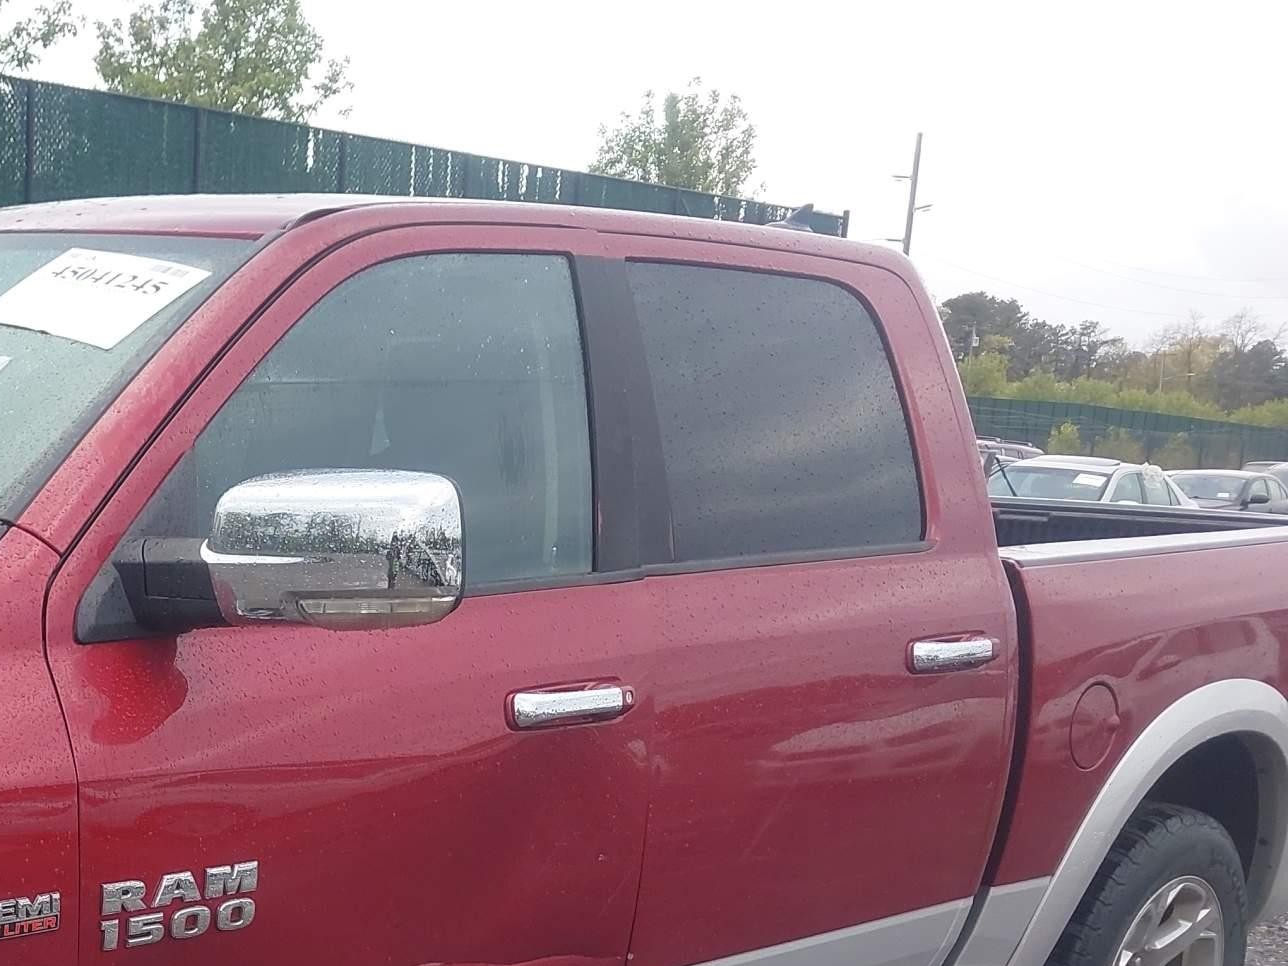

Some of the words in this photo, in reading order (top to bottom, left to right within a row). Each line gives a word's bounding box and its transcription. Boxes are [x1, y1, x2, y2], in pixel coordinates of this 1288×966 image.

[51, 265, 169, 294] 45041245
[100, 860, 259, 916] RAM
[3, 916, 57, 937] LITER
[100, 897, 257, 951] 1500
